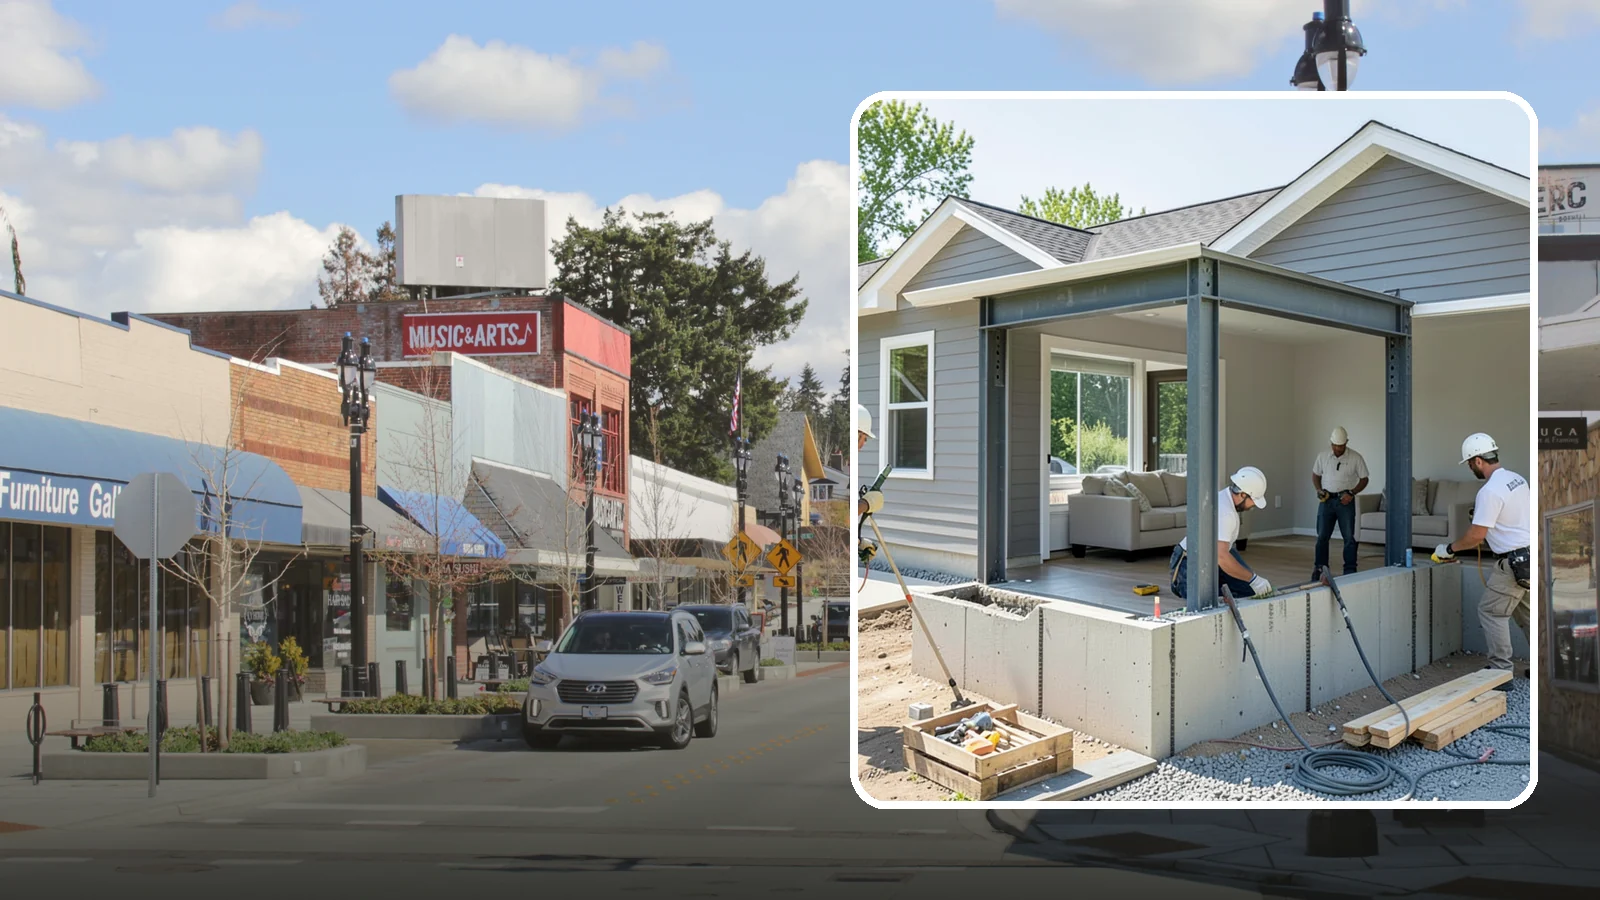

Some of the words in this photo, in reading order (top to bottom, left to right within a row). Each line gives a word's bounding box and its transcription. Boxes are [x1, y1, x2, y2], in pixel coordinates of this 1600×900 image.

[409, 323, 520, 349] MUSIC&ARTS
[0, 472, 80, 516] Furniture
[453, 562, 480, 575] SUSHI
